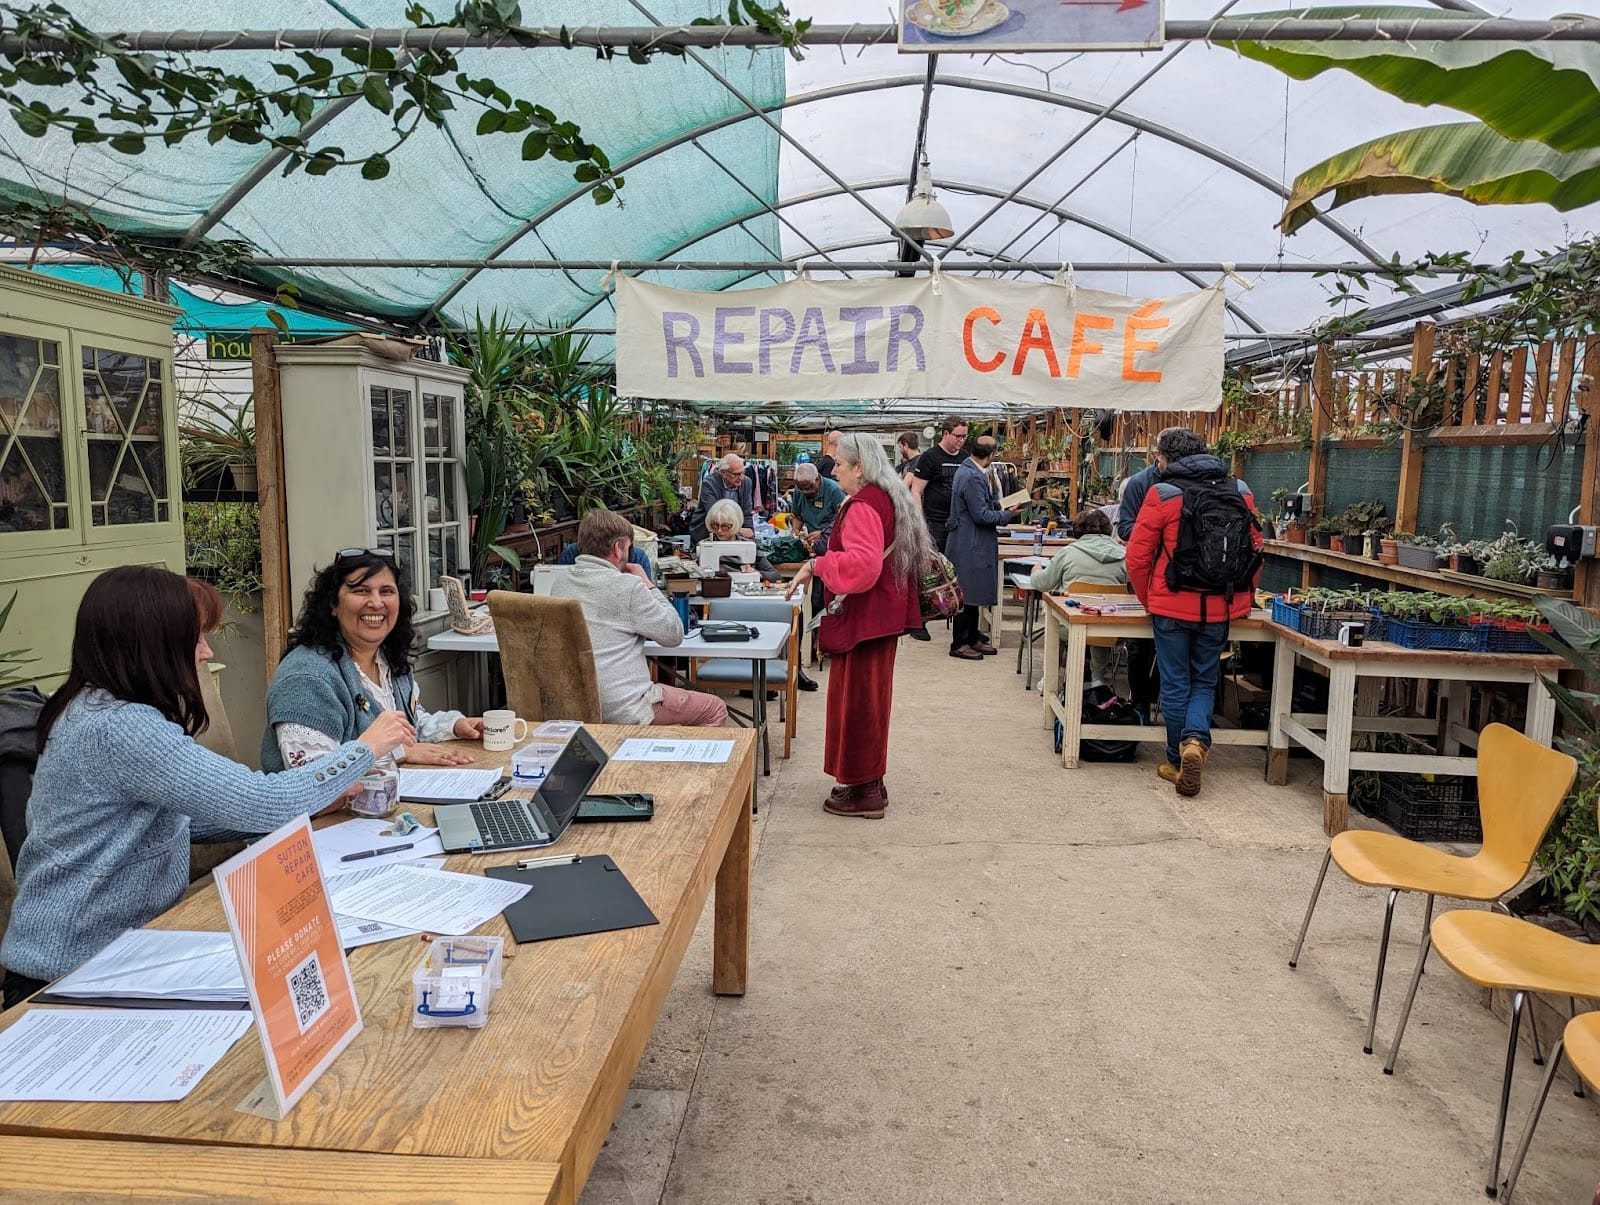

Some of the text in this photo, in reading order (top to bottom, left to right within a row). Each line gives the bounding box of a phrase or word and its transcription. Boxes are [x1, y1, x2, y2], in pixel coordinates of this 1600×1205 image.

[661, 300, 1171, 383] REPAIR CAFÉ
[277, 837, 308, 864] SUTTON
[284, 851, 312, 876] REPAIR
[266, 937, 294, 965] PLEASE
[294, 915, 321, 943] DONATE
